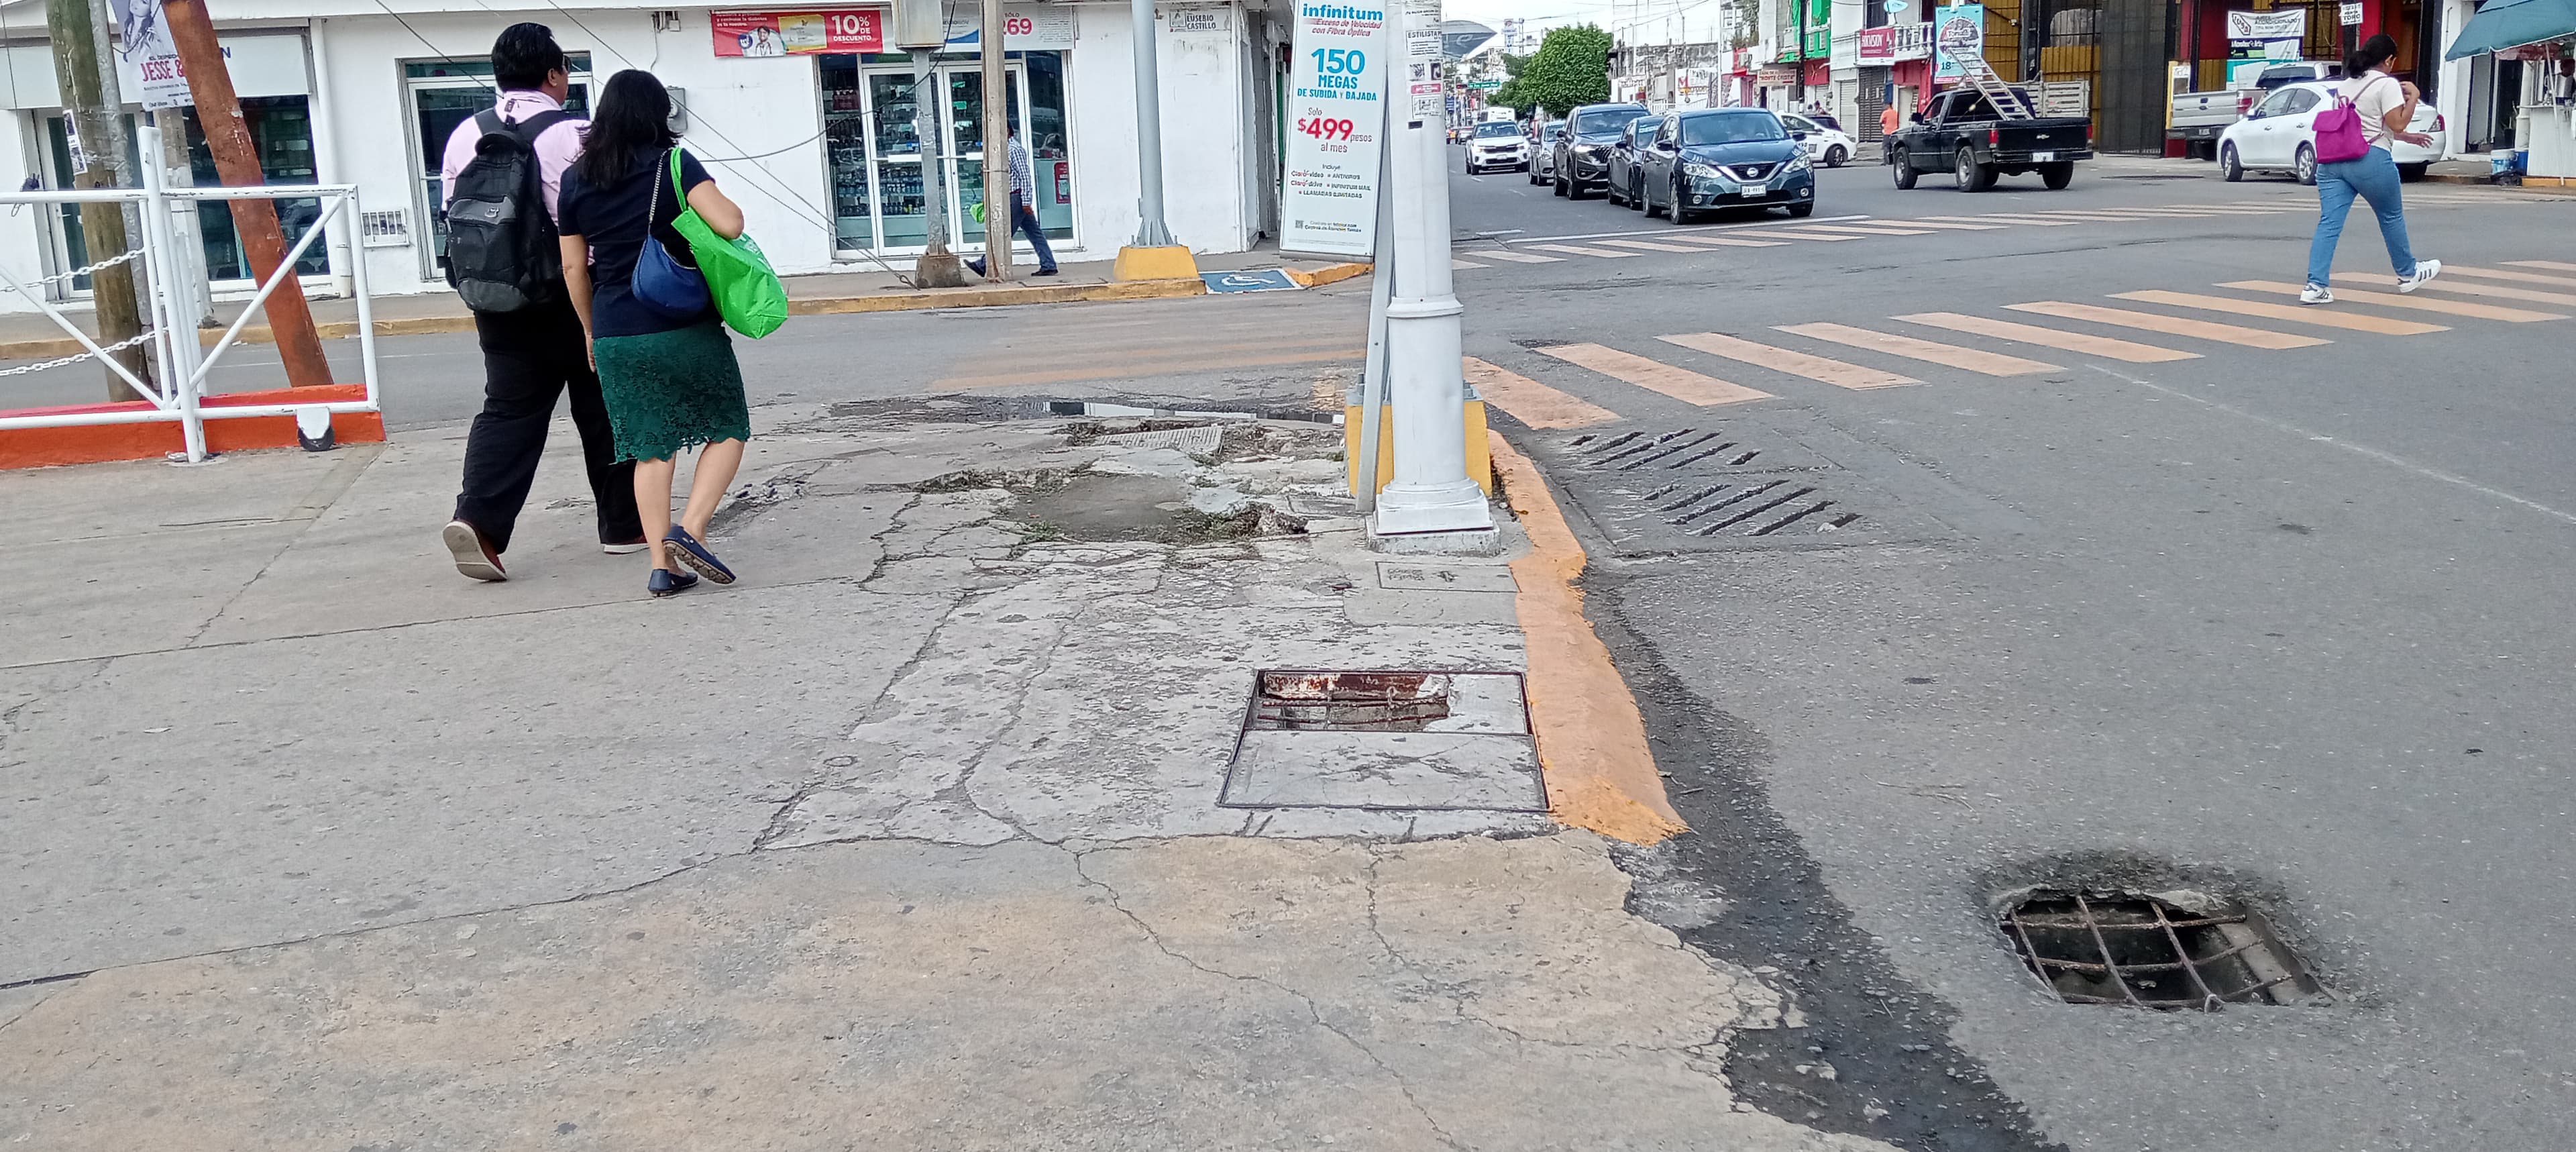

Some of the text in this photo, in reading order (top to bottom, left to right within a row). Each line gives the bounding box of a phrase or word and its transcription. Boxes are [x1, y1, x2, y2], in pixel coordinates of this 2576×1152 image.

[1303, 3, 1383, 21] infinitum
[1326, 27, 1346, 36] Fibra
[1350, 21, 1383, 29] Velocidad
[1311, 48, 1365, 74] 150
[140, 60, 173, 82] JESSE
[1318, 74, 1358, 89] MEGAS
[1297, 88, 1307, 97] DE
[1309, 89, 1337, 99] SUBIDA
[1346, 91, 1377, 101] BAJADA
[1308, 107, 1322, 115] Solo
[1297, 117, 1373, 143] $499 pesos
[1320, 142, 1348, 153] al mes
[1303, 189, 1332, 197] LLAMADAS
